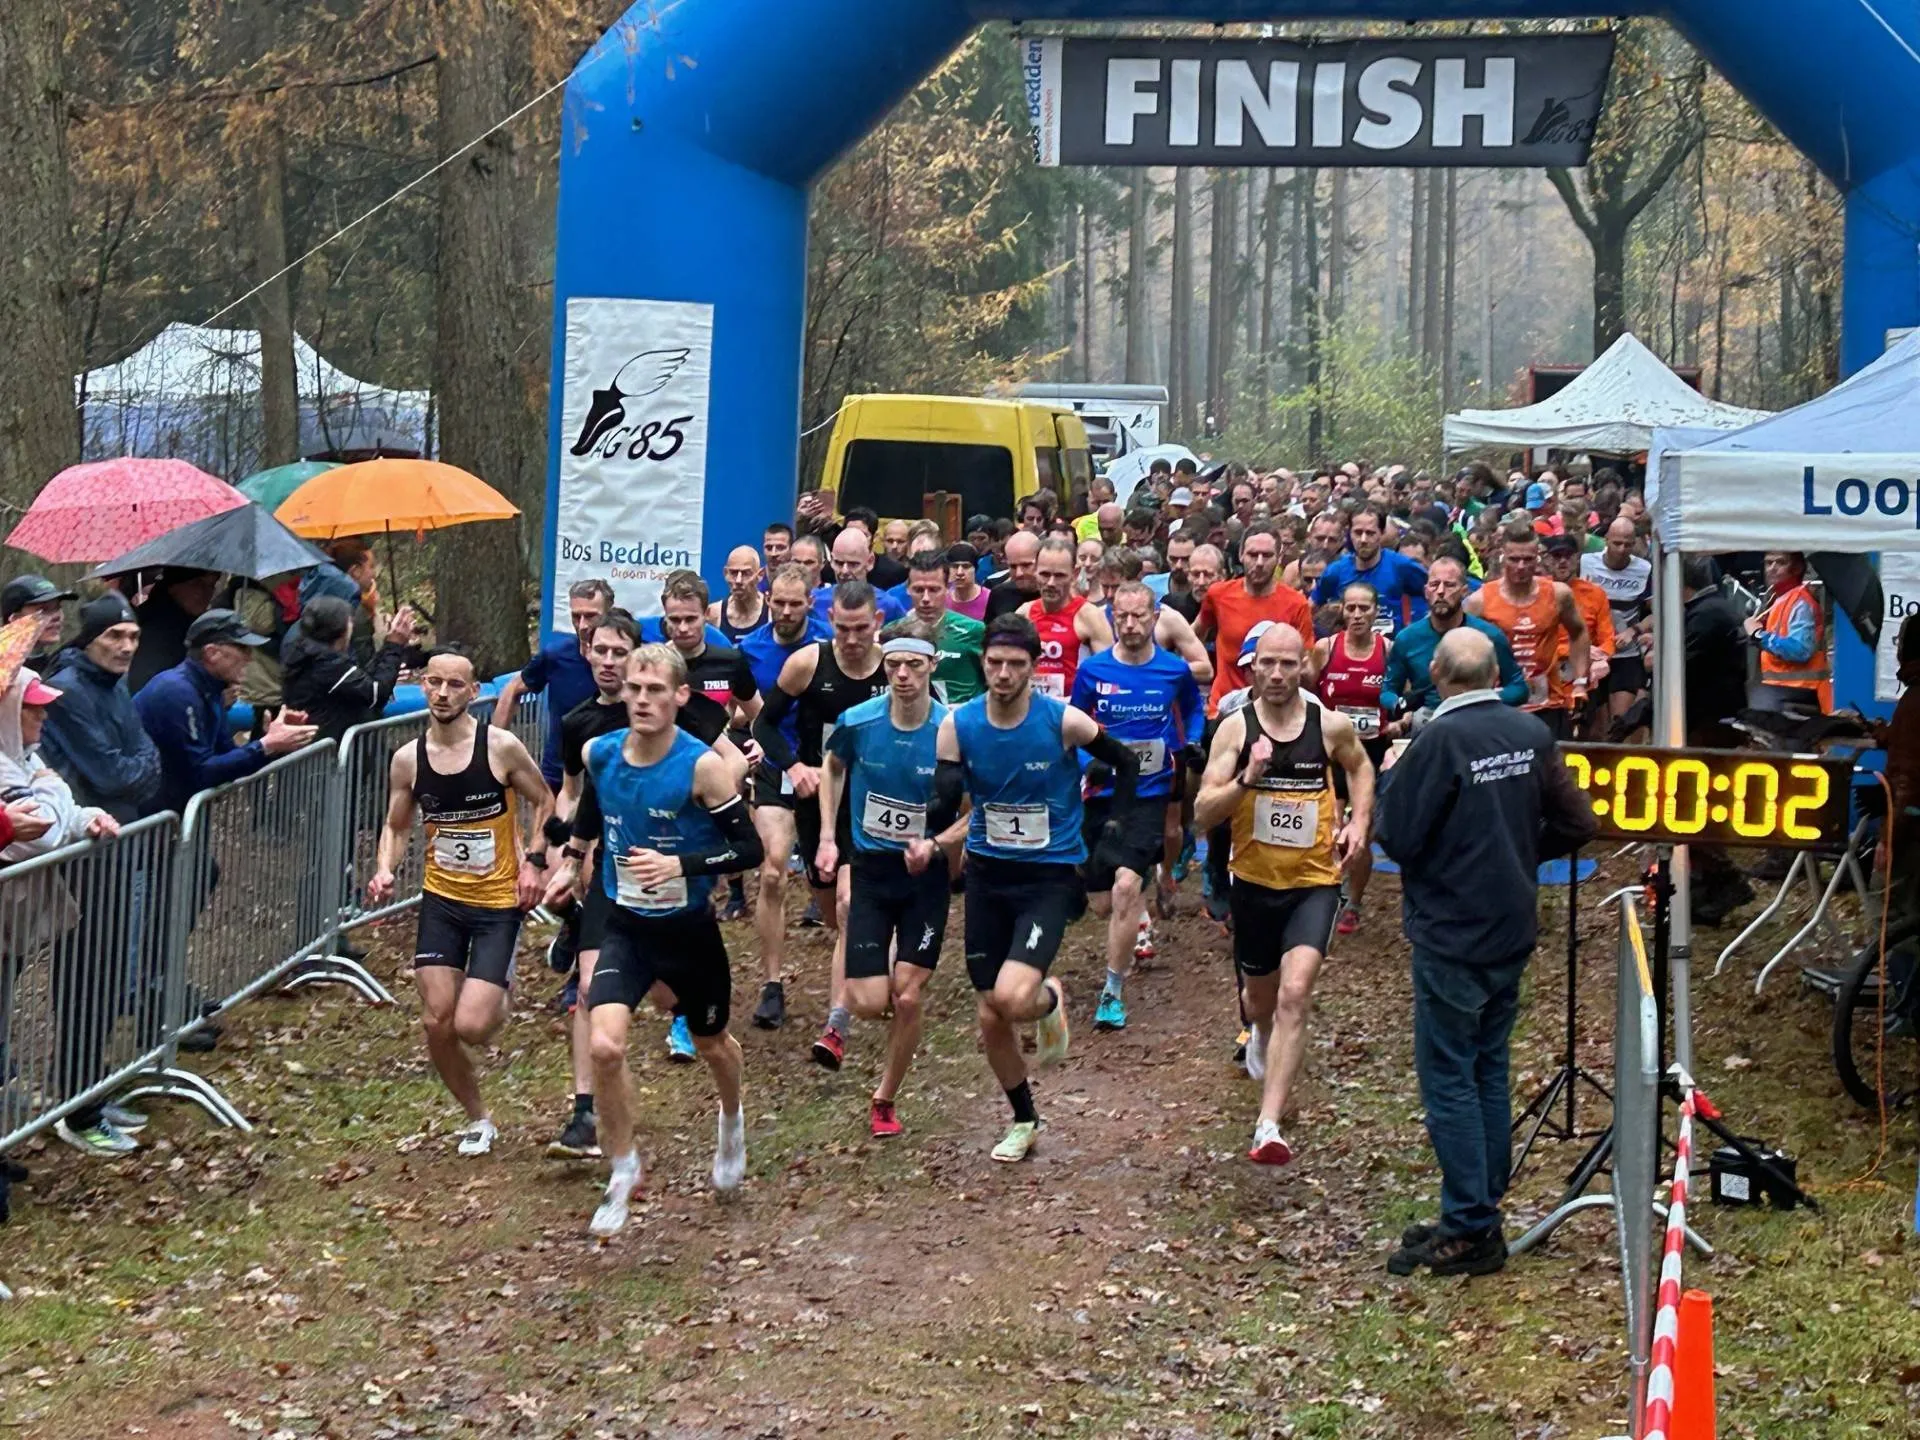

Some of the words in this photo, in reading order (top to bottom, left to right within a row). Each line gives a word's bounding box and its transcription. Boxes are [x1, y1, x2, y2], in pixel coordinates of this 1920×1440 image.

[1023, 40, 1043, 118] Bedden
[1105, 57, 1515, 149] FINISH
[1803, 466, 1920, 530] Loo
[562, 536, 592, 562] Bos
[600, 541, 691, 567] Bedden
[611, 567, 647, 580] Droom
[878, 810, 910, 831] 49
[1010, 816, 1024, 836] 1
[1271, 813, 1302, 830] 626
[455, 843, 470, 861] 3
